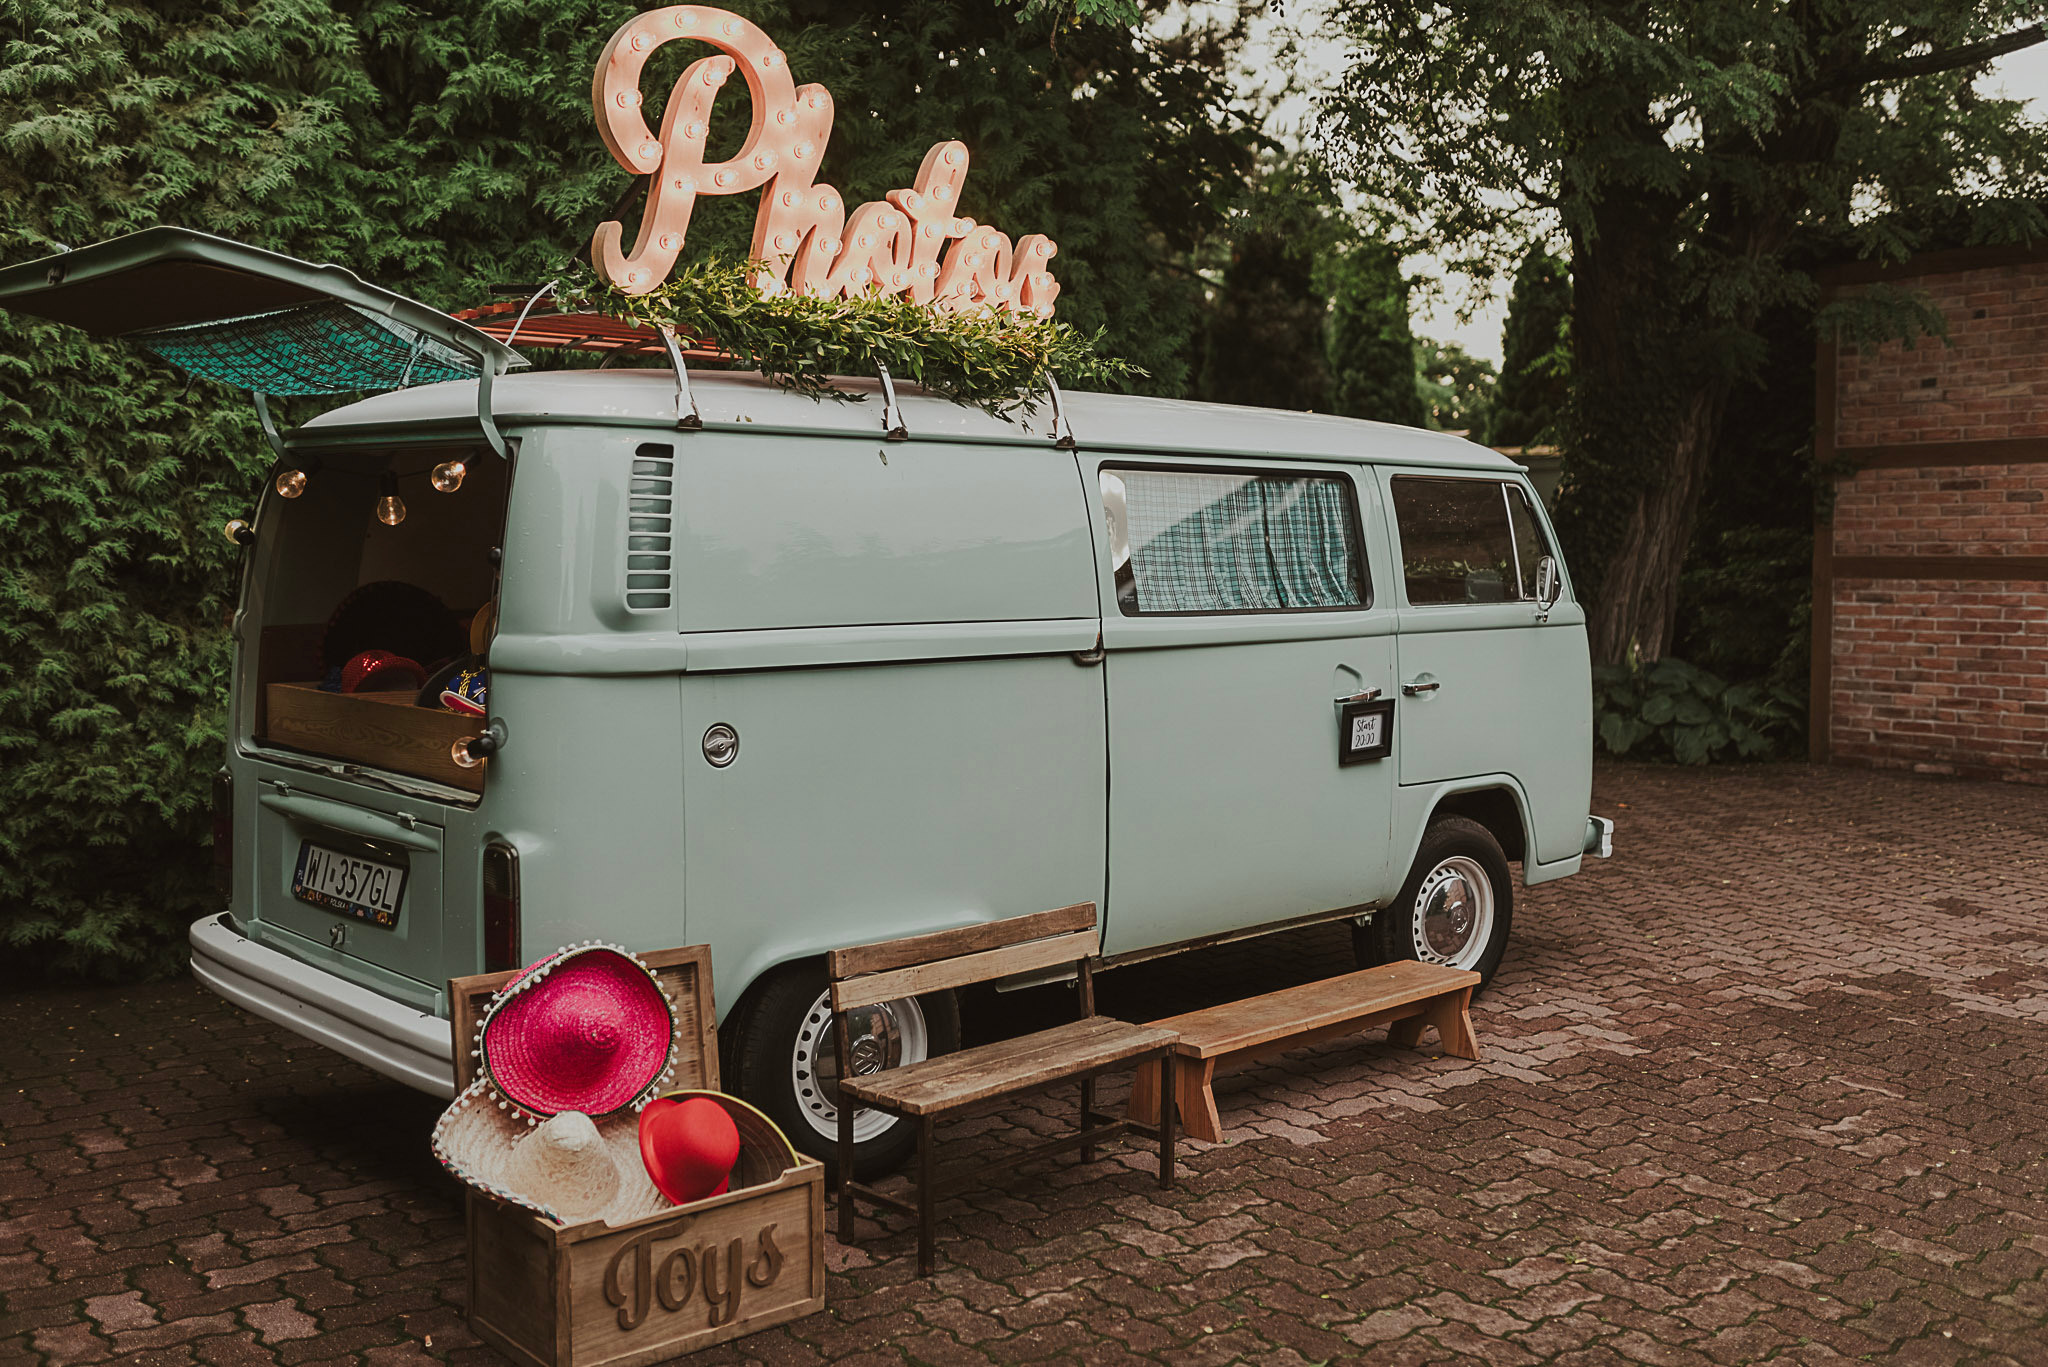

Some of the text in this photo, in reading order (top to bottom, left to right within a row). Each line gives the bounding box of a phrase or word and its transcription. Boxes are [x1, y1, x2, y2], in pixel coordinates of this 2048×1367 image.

[592, 4, 1061, 326] Photos
[1356, 716, 1376, 733] Start
[604, 1213, 784, 1331] Toys
